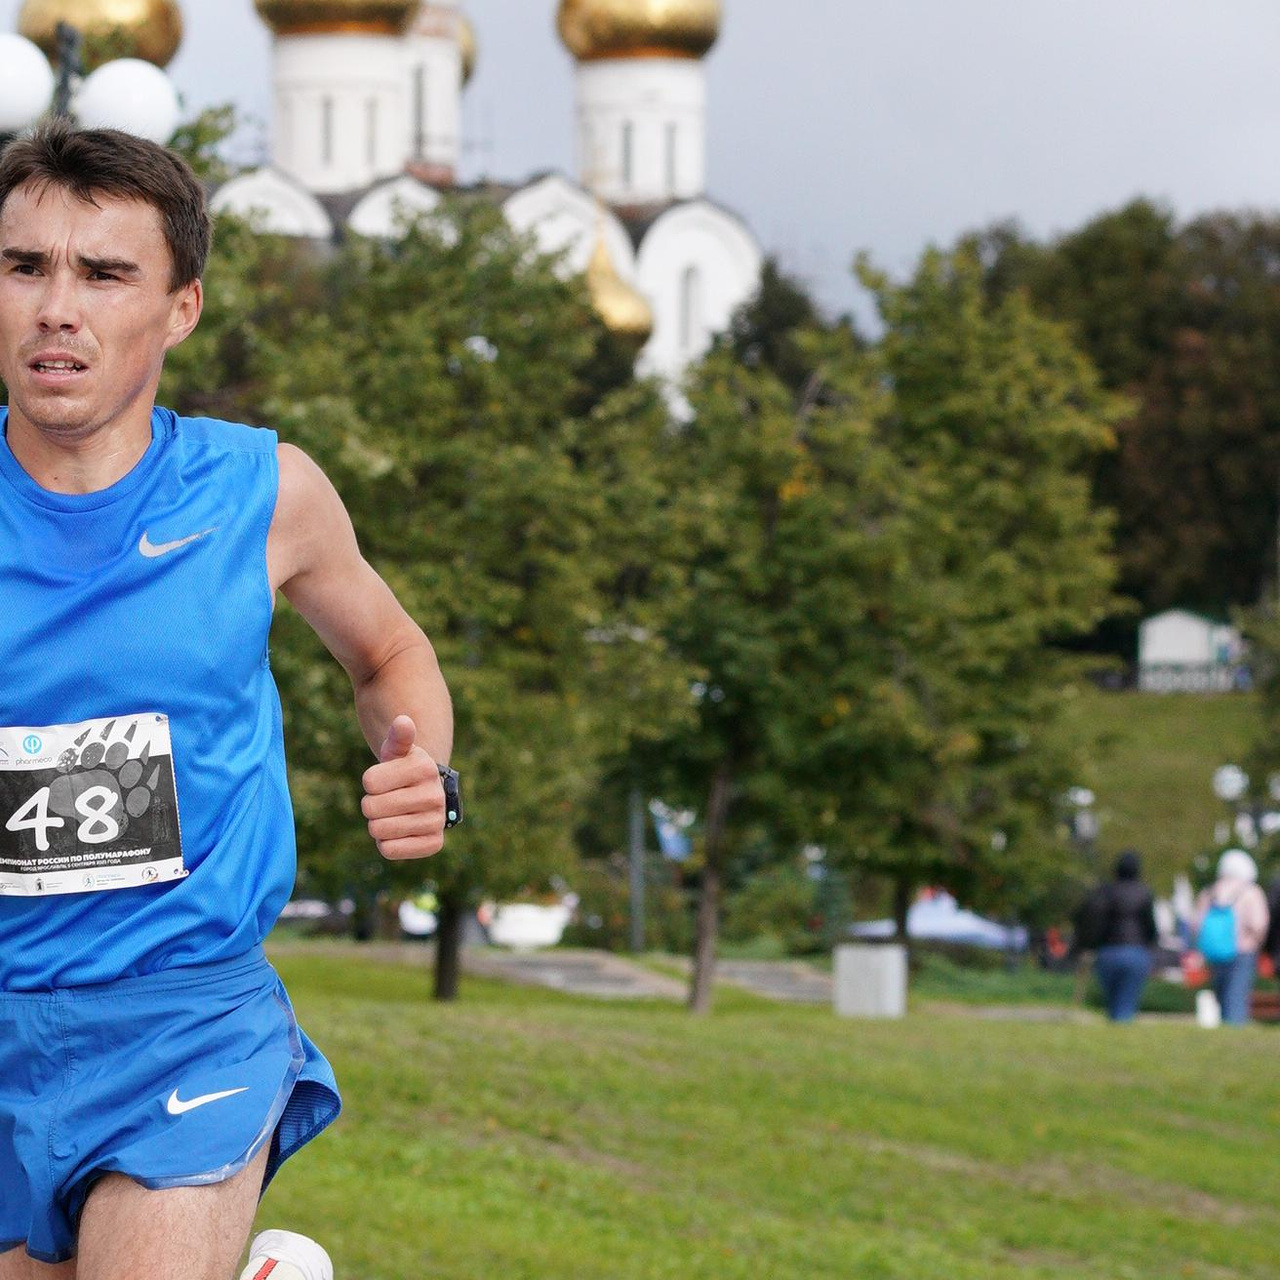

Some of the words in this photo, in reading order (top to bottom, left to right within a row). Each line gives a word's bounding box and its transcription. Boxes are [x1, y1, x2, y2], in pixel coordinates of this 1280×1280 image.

[15, 756, 53, 766] pharmeco
[5, 785, 120, 852] 48
[37, 856, 70, 866] РОССИИ
[70, 854, 83, 863] ПО
[82, 847, 152, 861] ПОЛУМАРАФОНУ
